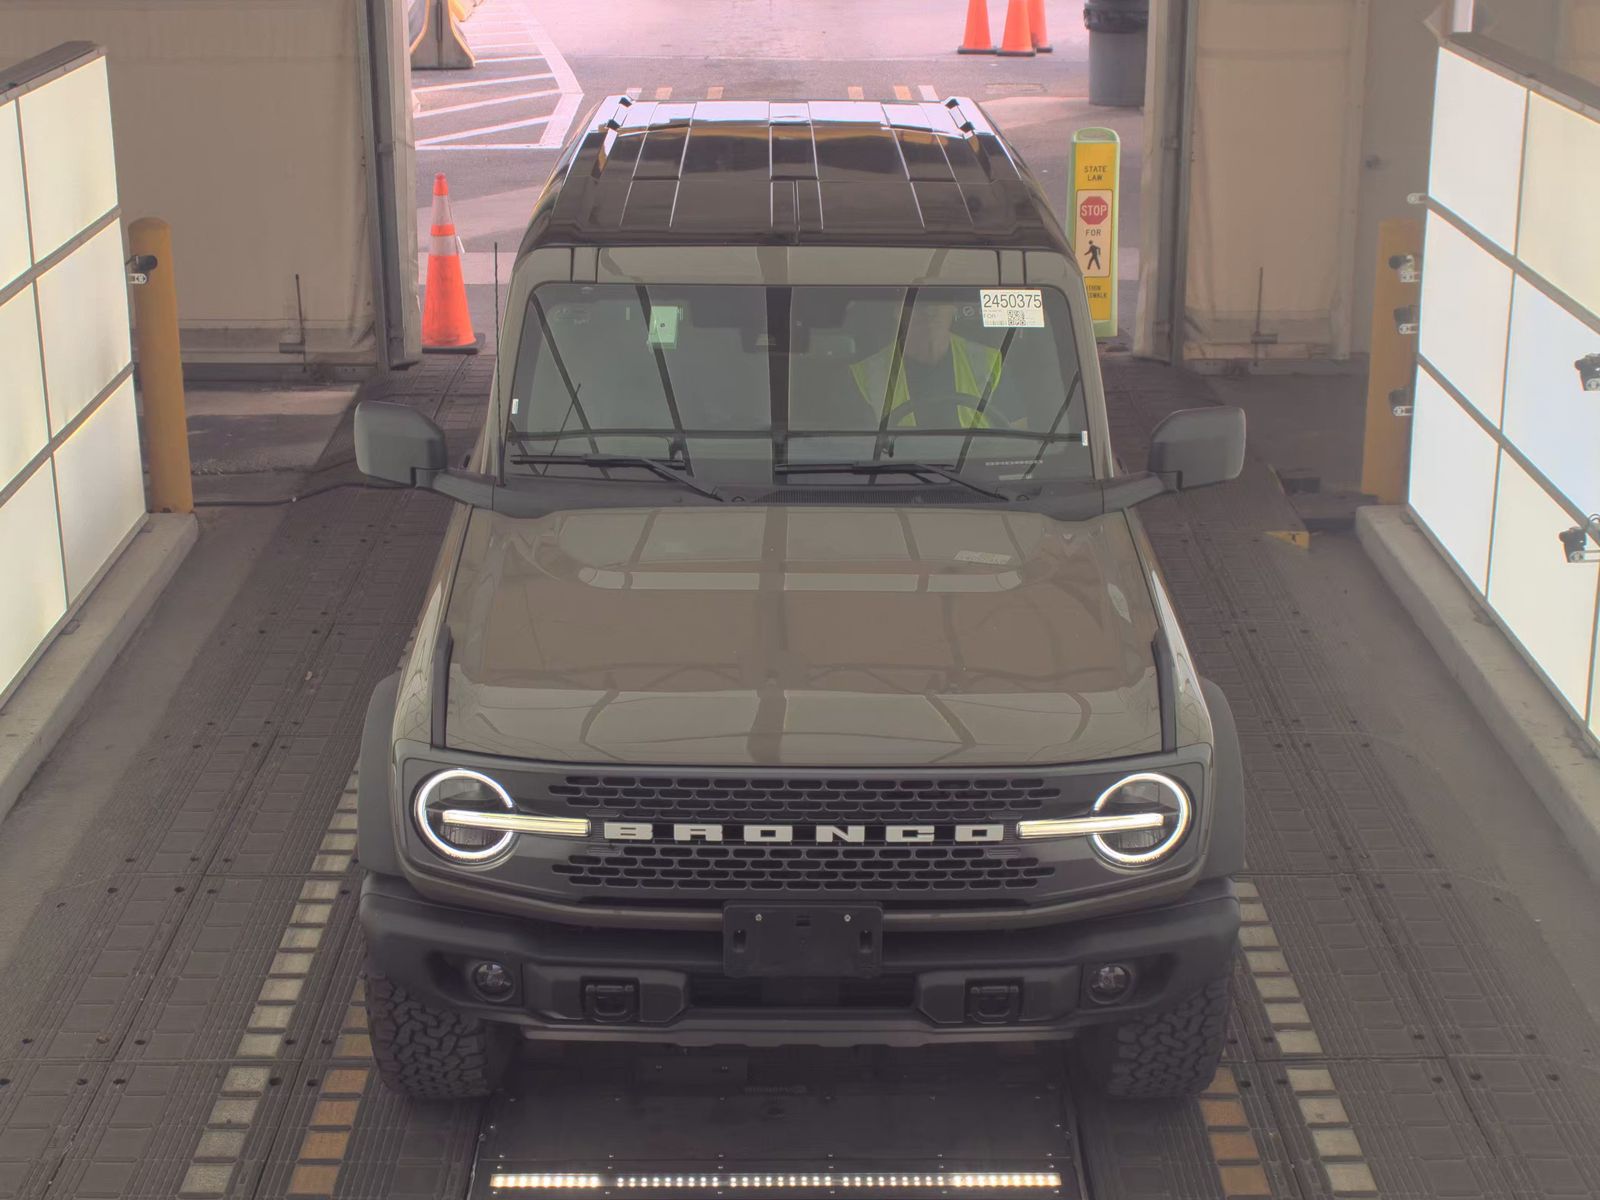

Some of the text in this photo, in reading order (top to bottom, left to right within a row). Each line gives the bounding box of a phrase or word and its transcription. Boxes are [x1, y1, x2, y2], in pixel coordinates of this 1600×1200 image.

[1084, 165, 1107, 173] STATE
[1081, 204, 1107, 216] STOP
[1085, 228, 1101, 236] FOR
[983, 294, 1042, 308] 2450375
[603, 822, 1005, 843] BRONCO
